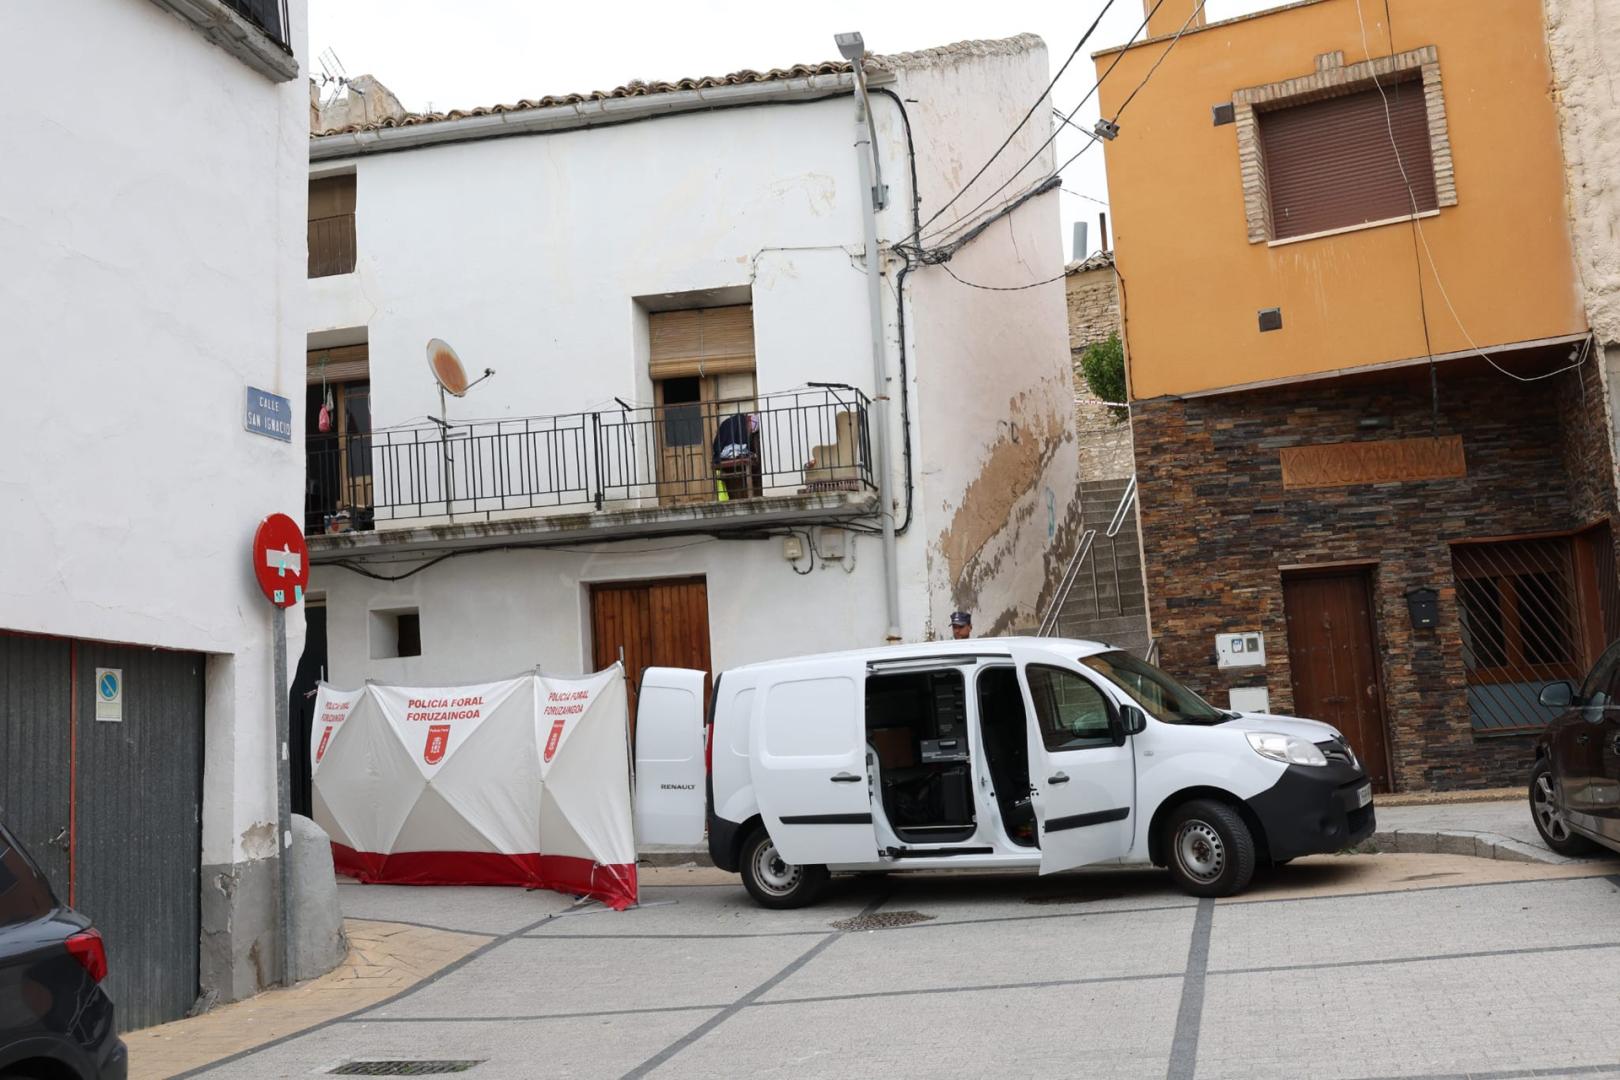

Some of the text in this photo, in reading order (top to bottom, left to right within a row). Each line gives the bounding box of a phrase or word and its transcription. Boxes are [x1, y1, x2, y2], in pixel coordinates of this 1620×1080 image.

[259, 396, 280, 412] CALLE
[247, 411, 291, 435] SAN IGNACIO
[451, 696, 485, 707] FORAL
[406, 709, 480, 721] FORUZAINGOA
[544, 704, 583, 715] FORUZAINGOA
